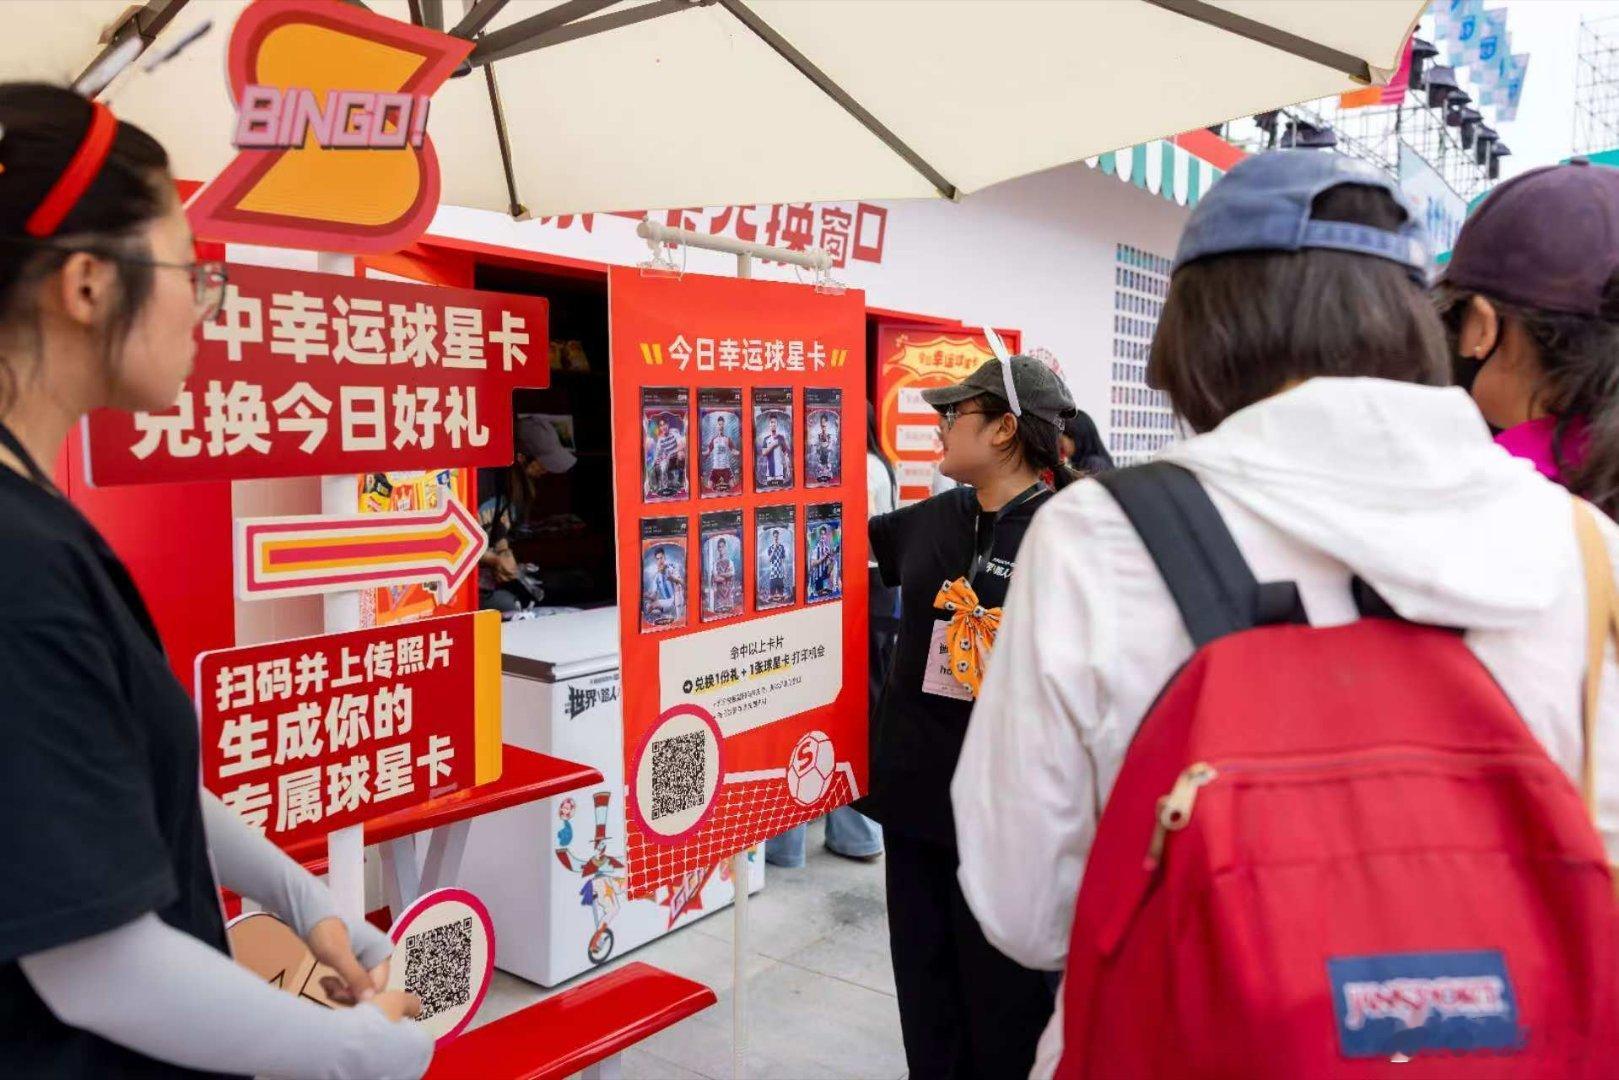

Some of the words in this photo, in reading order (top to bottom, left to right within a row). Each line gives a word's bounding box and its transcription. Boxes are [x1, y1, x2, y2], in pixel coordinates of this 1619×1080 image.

[233, 85, 431, 150] BINGO!
[203, 285, 530, 371] 中幸运球星卡
[668, 335, 826, 372] 今日幸运球星卡
[130, 381, 489, 460] 兑换今日好礼
[216, 631, 454, 712] 扫码并上传照片
[730, 635, 784, 660] 命中以上卡片
[217, 682, 412, 778] 生成你的
[223, 735, 455, 835] 专属球星卡
